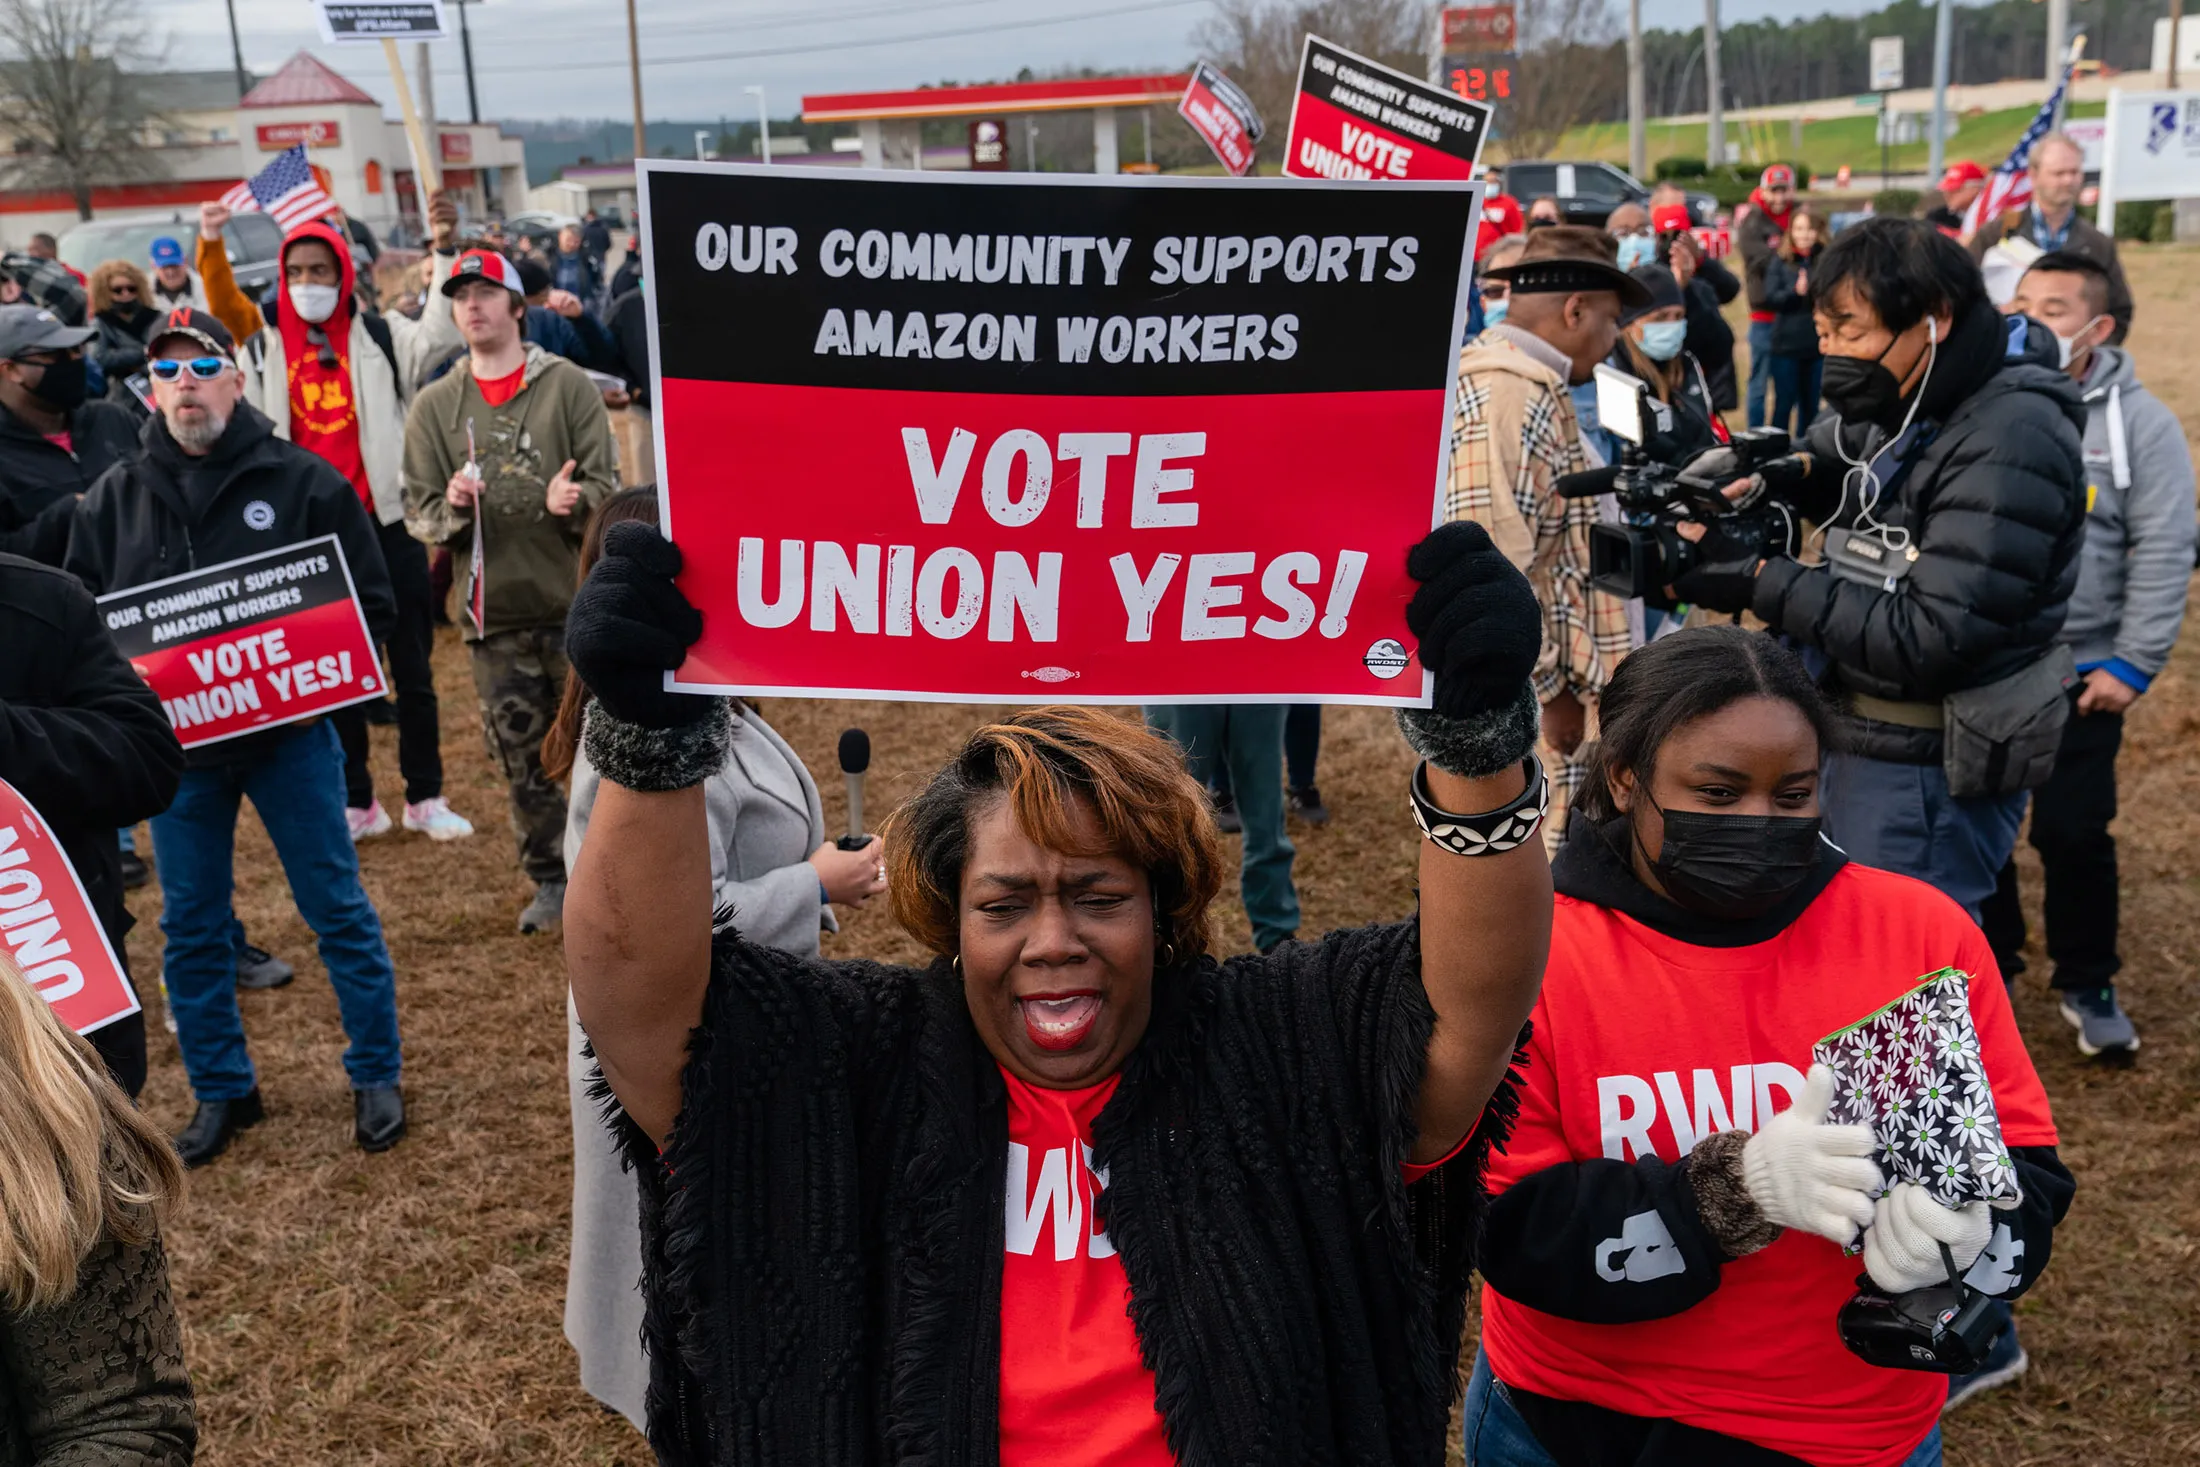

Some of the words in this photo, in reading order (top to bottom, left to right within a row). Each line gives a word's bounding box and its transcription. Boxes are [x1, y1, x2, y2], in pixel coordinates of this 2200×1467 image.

[1312, 53, 1336, 76] OUR
[1336, 65, 1406, 107] COMMUNITY
[1406, 94, 1476, 132] SUPPORTS
[1330, 85, 1381, 119] AMAZON
[1380, 106, 1442, 143] WORKERS
[1342, 121, 1413, 178] VOTE
[696, 223, 797, 275] OUR
[820, 230, 1131, 286] COMMUNITY
[1150, 235, 1419, 284] SUPPORTS
[168, 306, 193, 328] N
[814, 308, 1036, 362] AMAZON
[1057, 314, 1299, 364] WORKERS
[901, 427, 1207, 529] VOTE
[106, 606, 142, 631] OUR
[145, 578, 240, 620] COMMUNITY
[243, 555, 330, 592] SUPPORTS
[152, 610, 222, 643] AMAZON
[223, 587, 303, 624] WORKERS
[737, 537, 1063, 643] UNION
[1109, 549, 1367, 643] YES!
[186, 627, 291, 685] VOTE
[266, 650, 354, 702] YES!
